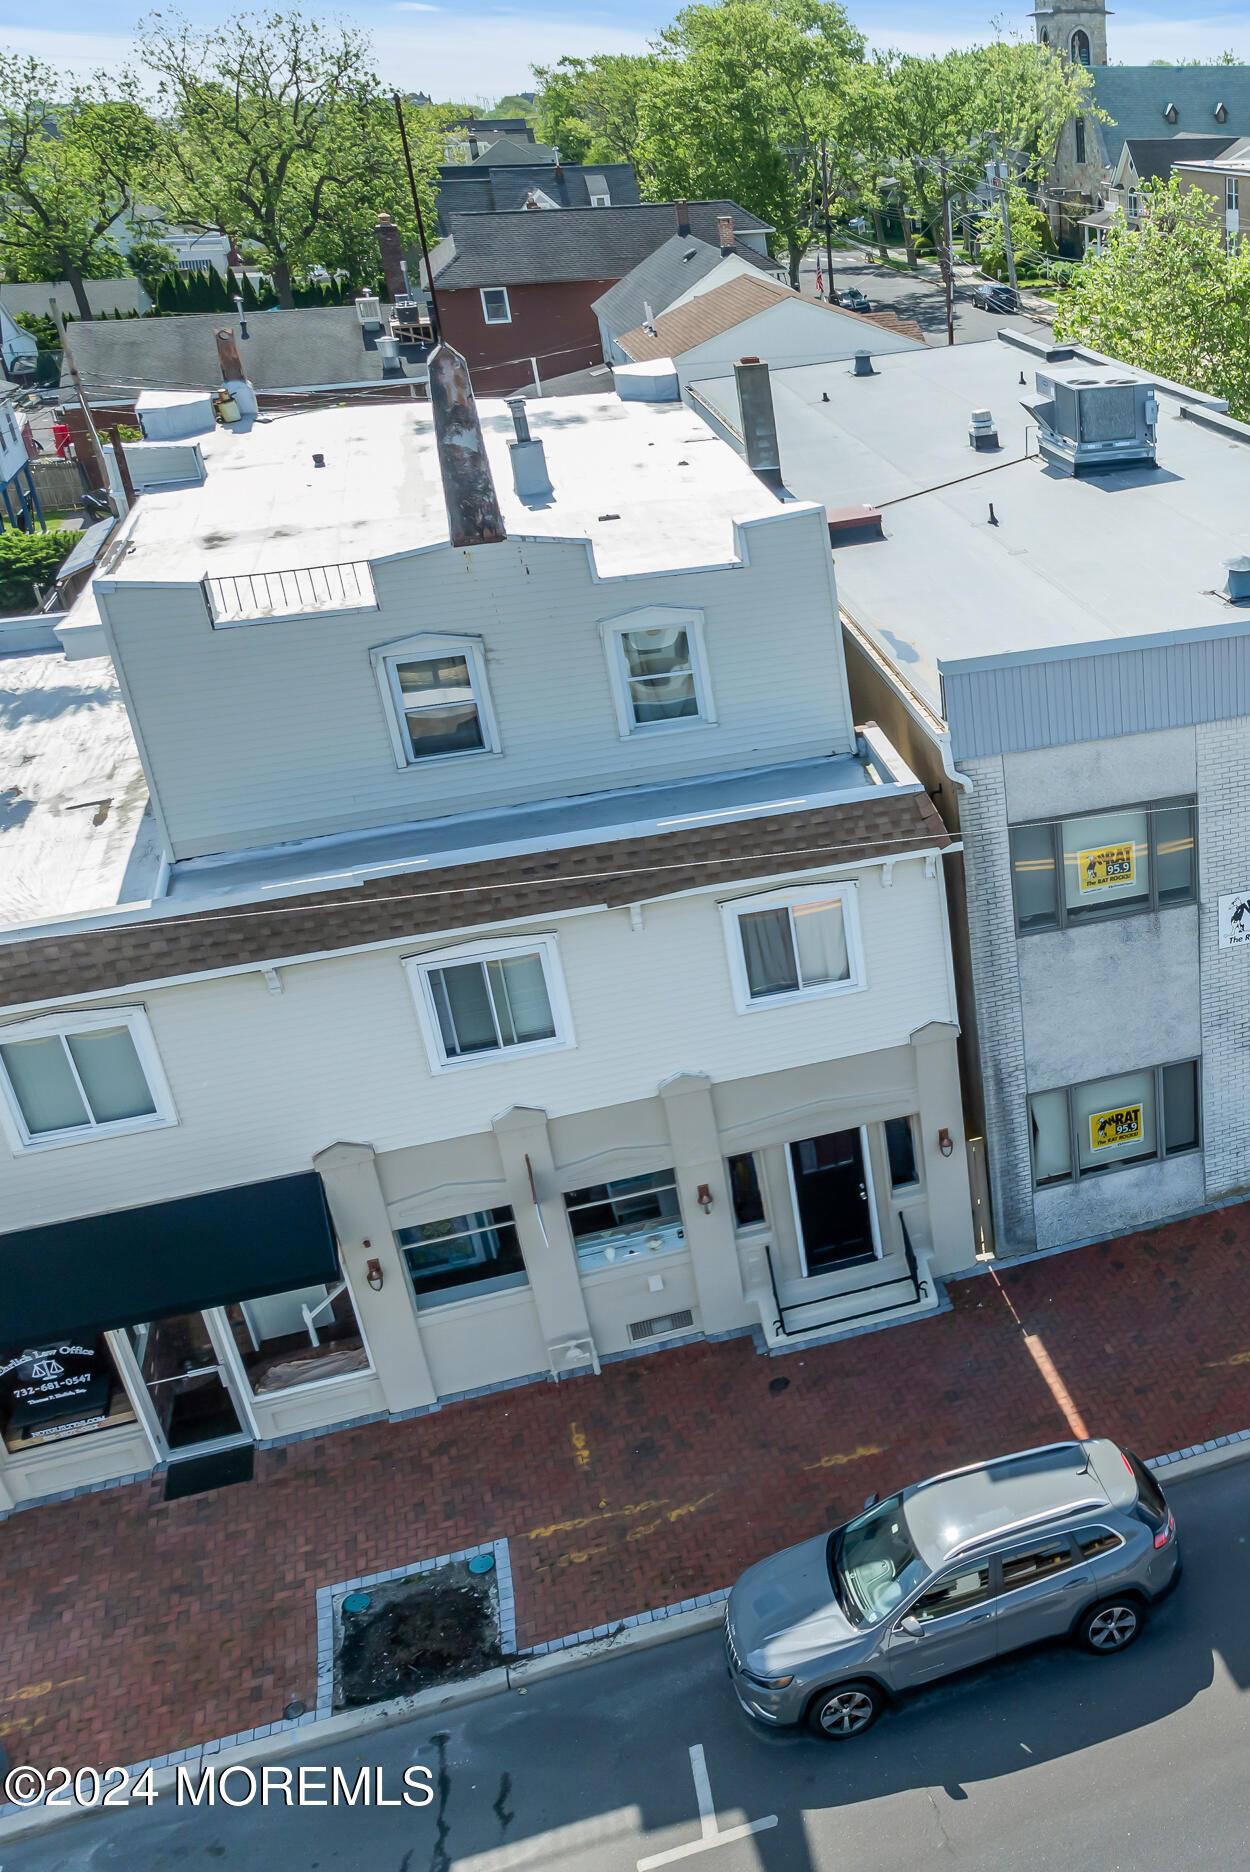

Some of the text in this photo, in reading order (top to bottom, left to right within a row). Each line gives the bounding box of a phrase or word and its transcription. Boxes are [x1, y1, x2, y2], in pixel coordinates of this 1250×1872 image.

[1107, 863, 1130, 875] 95.9
[1229, 935, 1243, 944] The
[1116, 1122, 1137, 1134] 95.9
[32, 1349, 58, 1358] Law
[59, 1345, 95, 1356] Office
[13, 1373, 91, 1398] 732-681-0547
